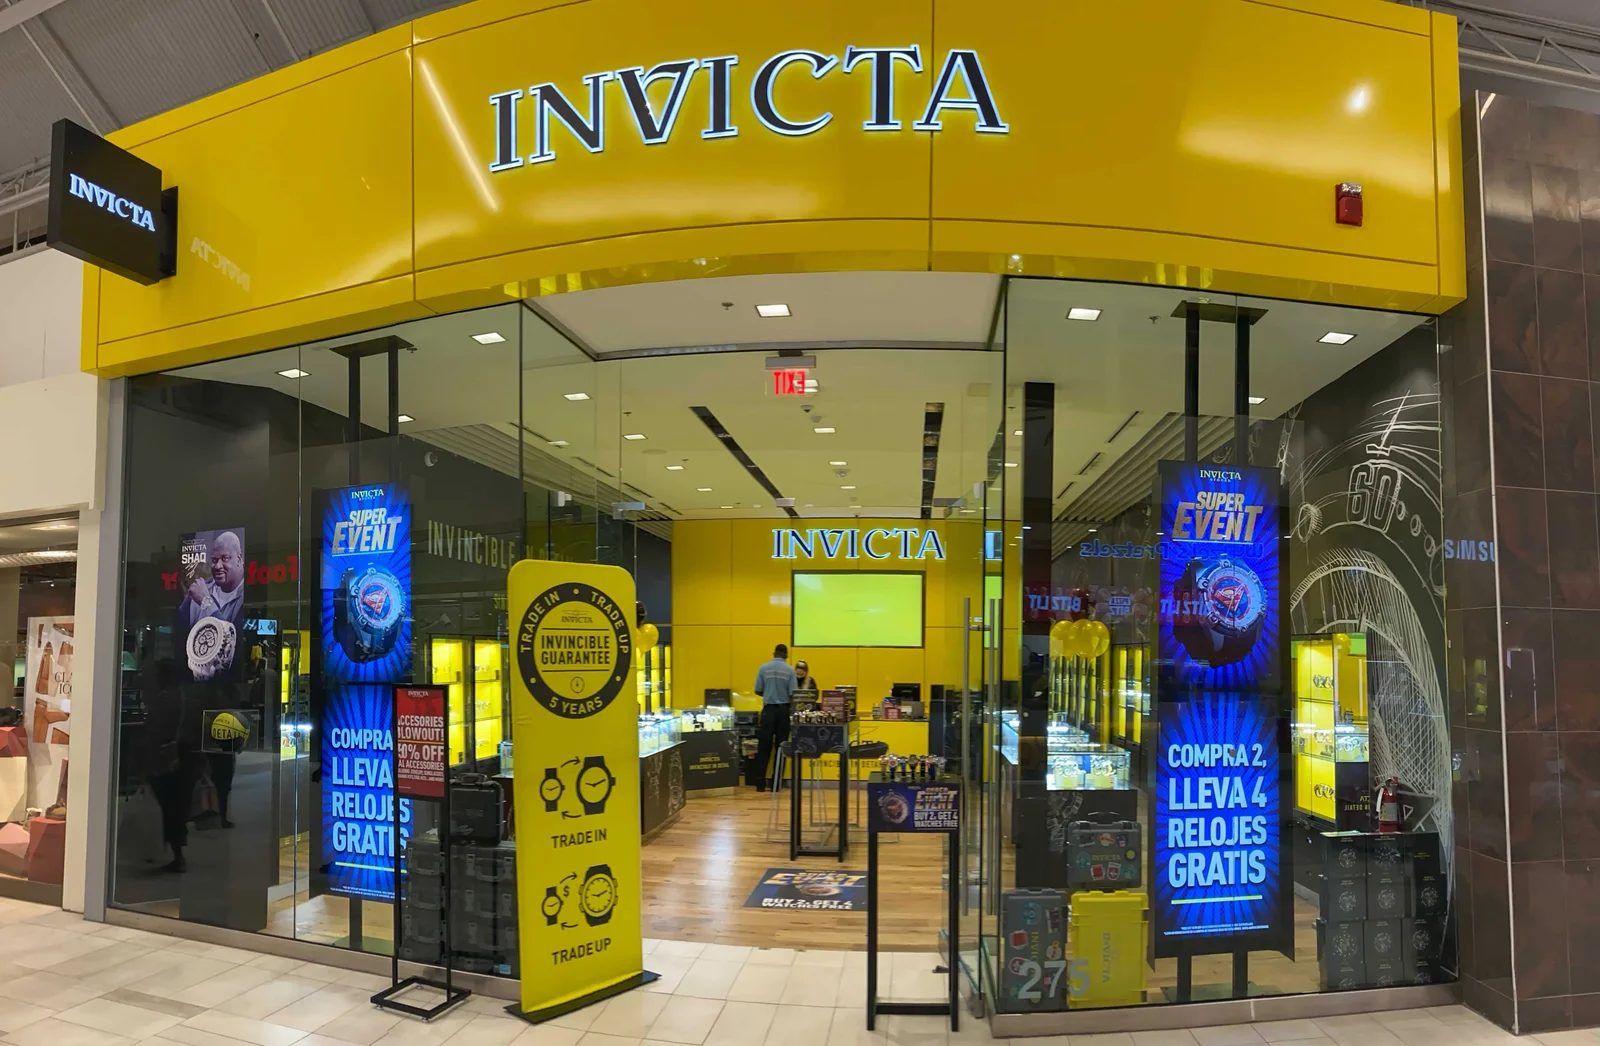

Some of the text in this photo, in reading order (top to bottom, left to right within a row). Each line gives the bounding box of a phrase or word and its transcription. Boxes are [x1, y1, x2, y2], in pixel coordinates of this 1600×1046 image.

[489, 45, 1010, 172] INVICTA
[69, 173, 156, 232] INVICTA
[1200, 469, 1242, 481] INVICTA
[351, 489, 385, 499] INVICTA
[1196, 491, 1245, 512] SUPER
[349, 507, 388, 527] SUPER
[1172, 501, 1264, 542] EVENT
[331, 516, 402, 553] EVENT
[428, 519, 516, 570] INVINCIBLE
[771, 528, 947, 560] INVICTA
[181, 543, 208, 553] INVICTA
[181, 552, 207, 565] SHAQ
[520, 590, 561, 653] TRADE IN
[590, 591, 630, 654] TRADE UP
[541, 635, 611, 649] INVINCIBLE
[541, 650, 611, 665] GUARANTEE
[549, 696, 603, 715] 5 YEARS
[398, 715, 444, 727] CCESORIES
[331, 727, 394, 751] COMPRA
[405, 760, 445, 771] ACCESSORIES
[422, 745, 445, 761] OFF
[1168, 743, 1267, 768] COMPRA 2,
[332, 756, 394, 789] LLEVA
[1168, 776, 1267, 811] LLEVA 4
[332, 791, 411, 824] RELOJES
[551, 828, 607, 849] TRADE IN
[1168, 815, 1267, 848] RELOJES
[1168, 850, 1266, 888] GRATIS
[552, 937, 612, 965] TRADE UP
[1018, 957, 1091, 999] 275
